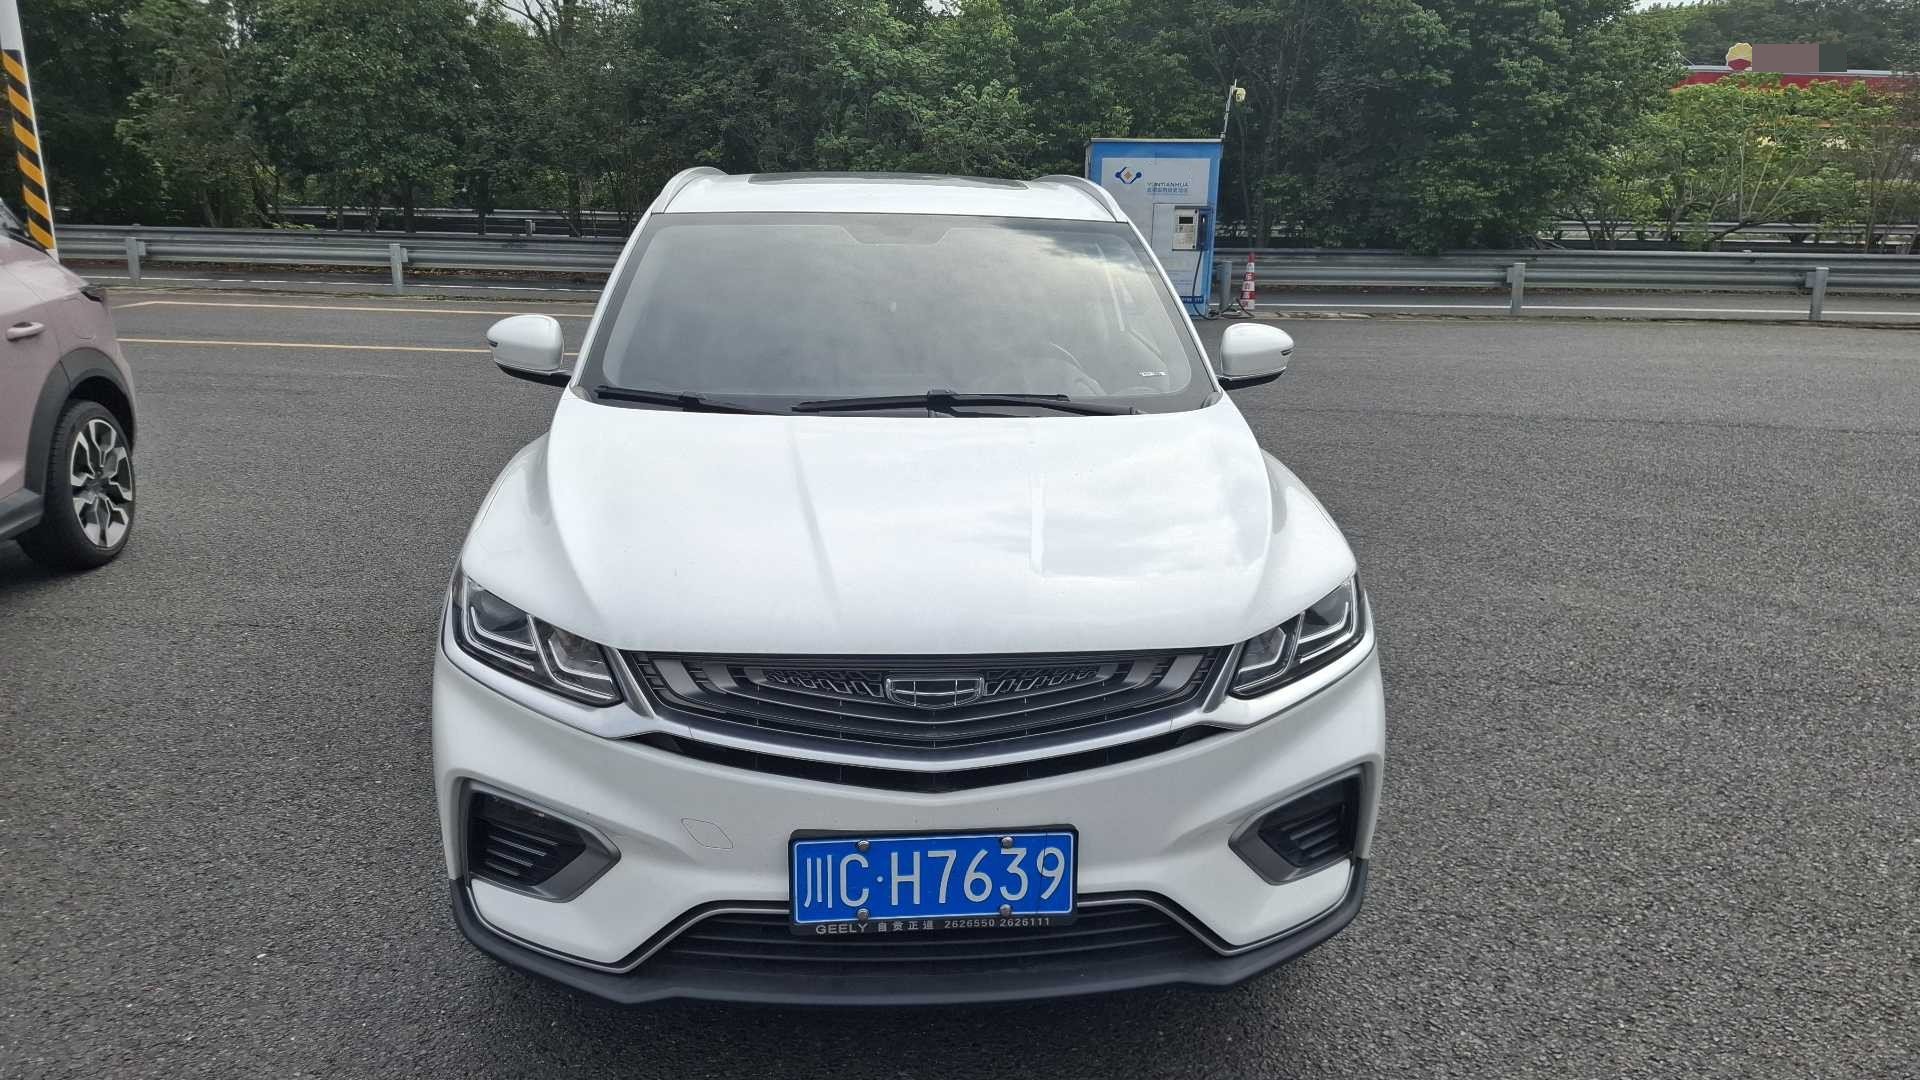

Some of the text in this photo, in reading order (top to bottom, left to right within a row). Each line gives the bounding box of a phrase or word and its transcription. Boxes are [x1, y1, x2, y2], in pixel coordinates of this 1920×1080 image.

[815, 923, 868, 935] GEELY
[944, 919, 995, 929] 2626550
[999, 918, 1050, 928] 2626111
